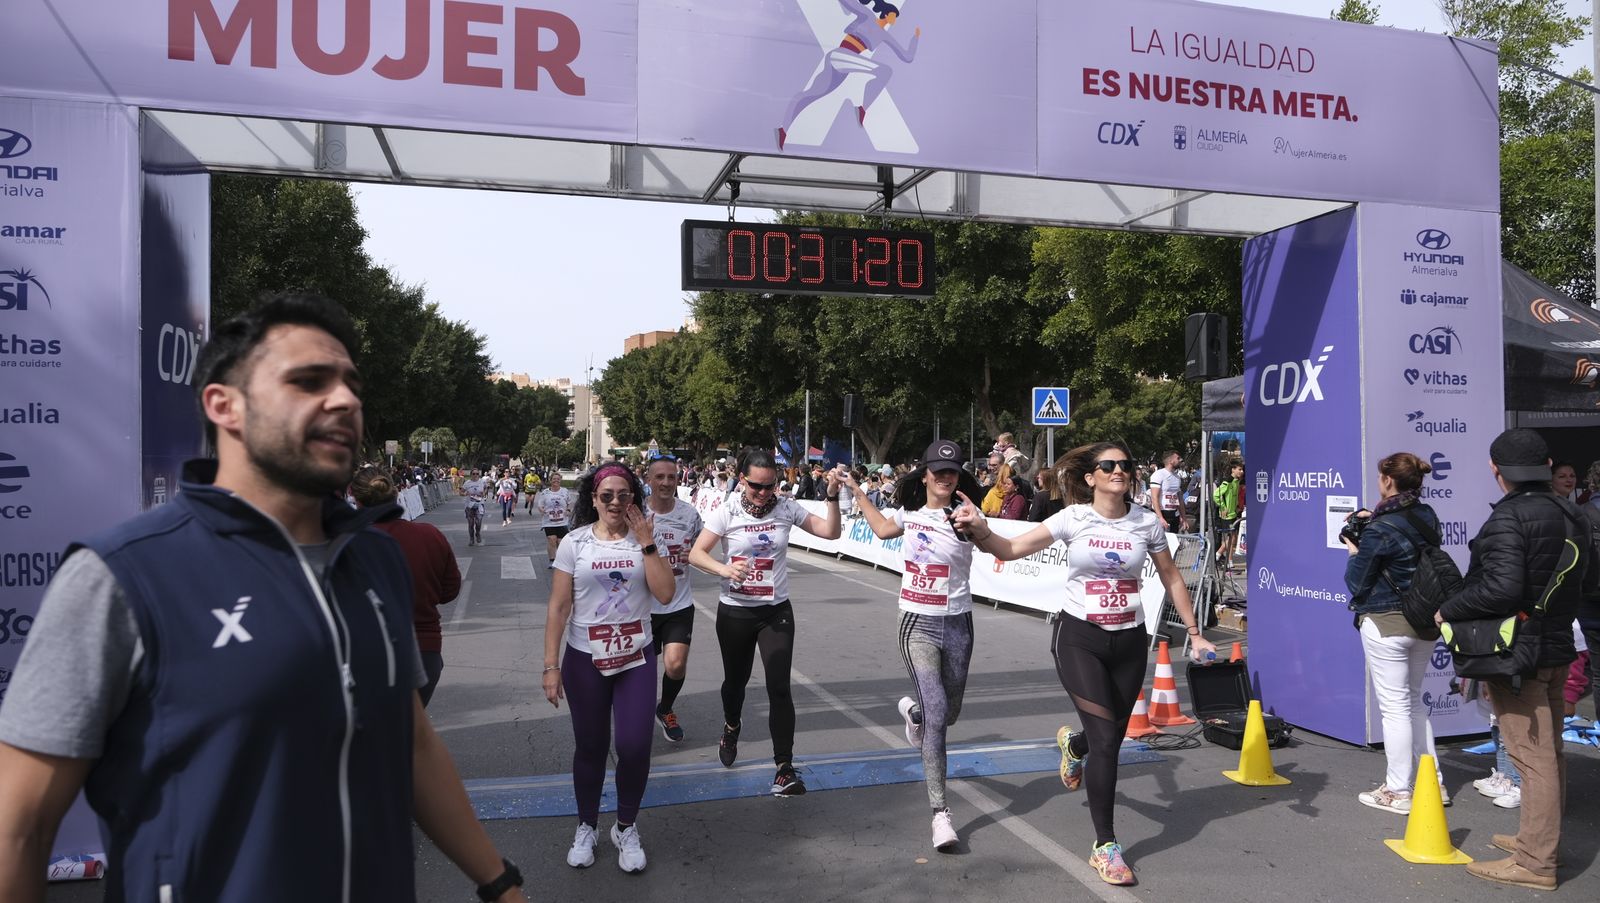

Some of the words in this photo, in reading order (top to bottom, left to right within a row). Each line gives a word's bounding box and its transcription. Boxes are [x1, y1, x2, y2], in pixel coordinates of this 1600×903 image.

[167, 0, 586, 97] MUJER
[1131, 26, 1165, 56] LA
[1174, 32, 1315, 74] IGUALDAD
[1083, 67, 1121, 97] ES
[1129, 72, 1267, 114] NUESTRA
[1273, 90, 1359, 123] META.
[1097, 121, 1143, 147] CDX
[1197, 129, 1248, 145] ALMERÍA
[1197, 141, 1224, 152] CIUDAD
[0, 165, 58, 181] NDAI
[0, 225, 67, 239] amar
[1403, 252, 1464, 265] HYUNDAI
[1412, 265, 1458, 277] Almerialva
[0, 282, 28, 311] SI
[1420, 291, 1469, 307] cajamar
[0, 333, 62, 355] thas
[1409, 333, 1452, 355] CASI
[0, 360, 17, 368] ara
[19, 359, 62, 368] cuidarte
[1259, 352, 1330, 407] CDX
[1423, 370, 1468, 386] vithas
[0, 402, 60, 424] ualia
[1415, 418, 1467, 437] aqualia
[1278, 468, 1345, 489] ALMERÍA
[1278, 490, 1310, 501] CIUDAD
[1420, 486, 1453, 499] Clece
[744, 524, 776, 533] MUJER
[1439, 521, 1468, 546] CASH
[1088, 538, 1133, 551] MUJER
[1021, 543, 1069, 568] MERÍA
[0, 551, 60, 587] CASH
[591, 560, 634, 570] MUJER
[1013, 562, 1041, 577] CIUDAD
[747, 570, 764, 582] 56
[911, 574, 937, 590] 857
[1099, 593, 1128, 608] 828
[602, 635, 634, 652] 712
